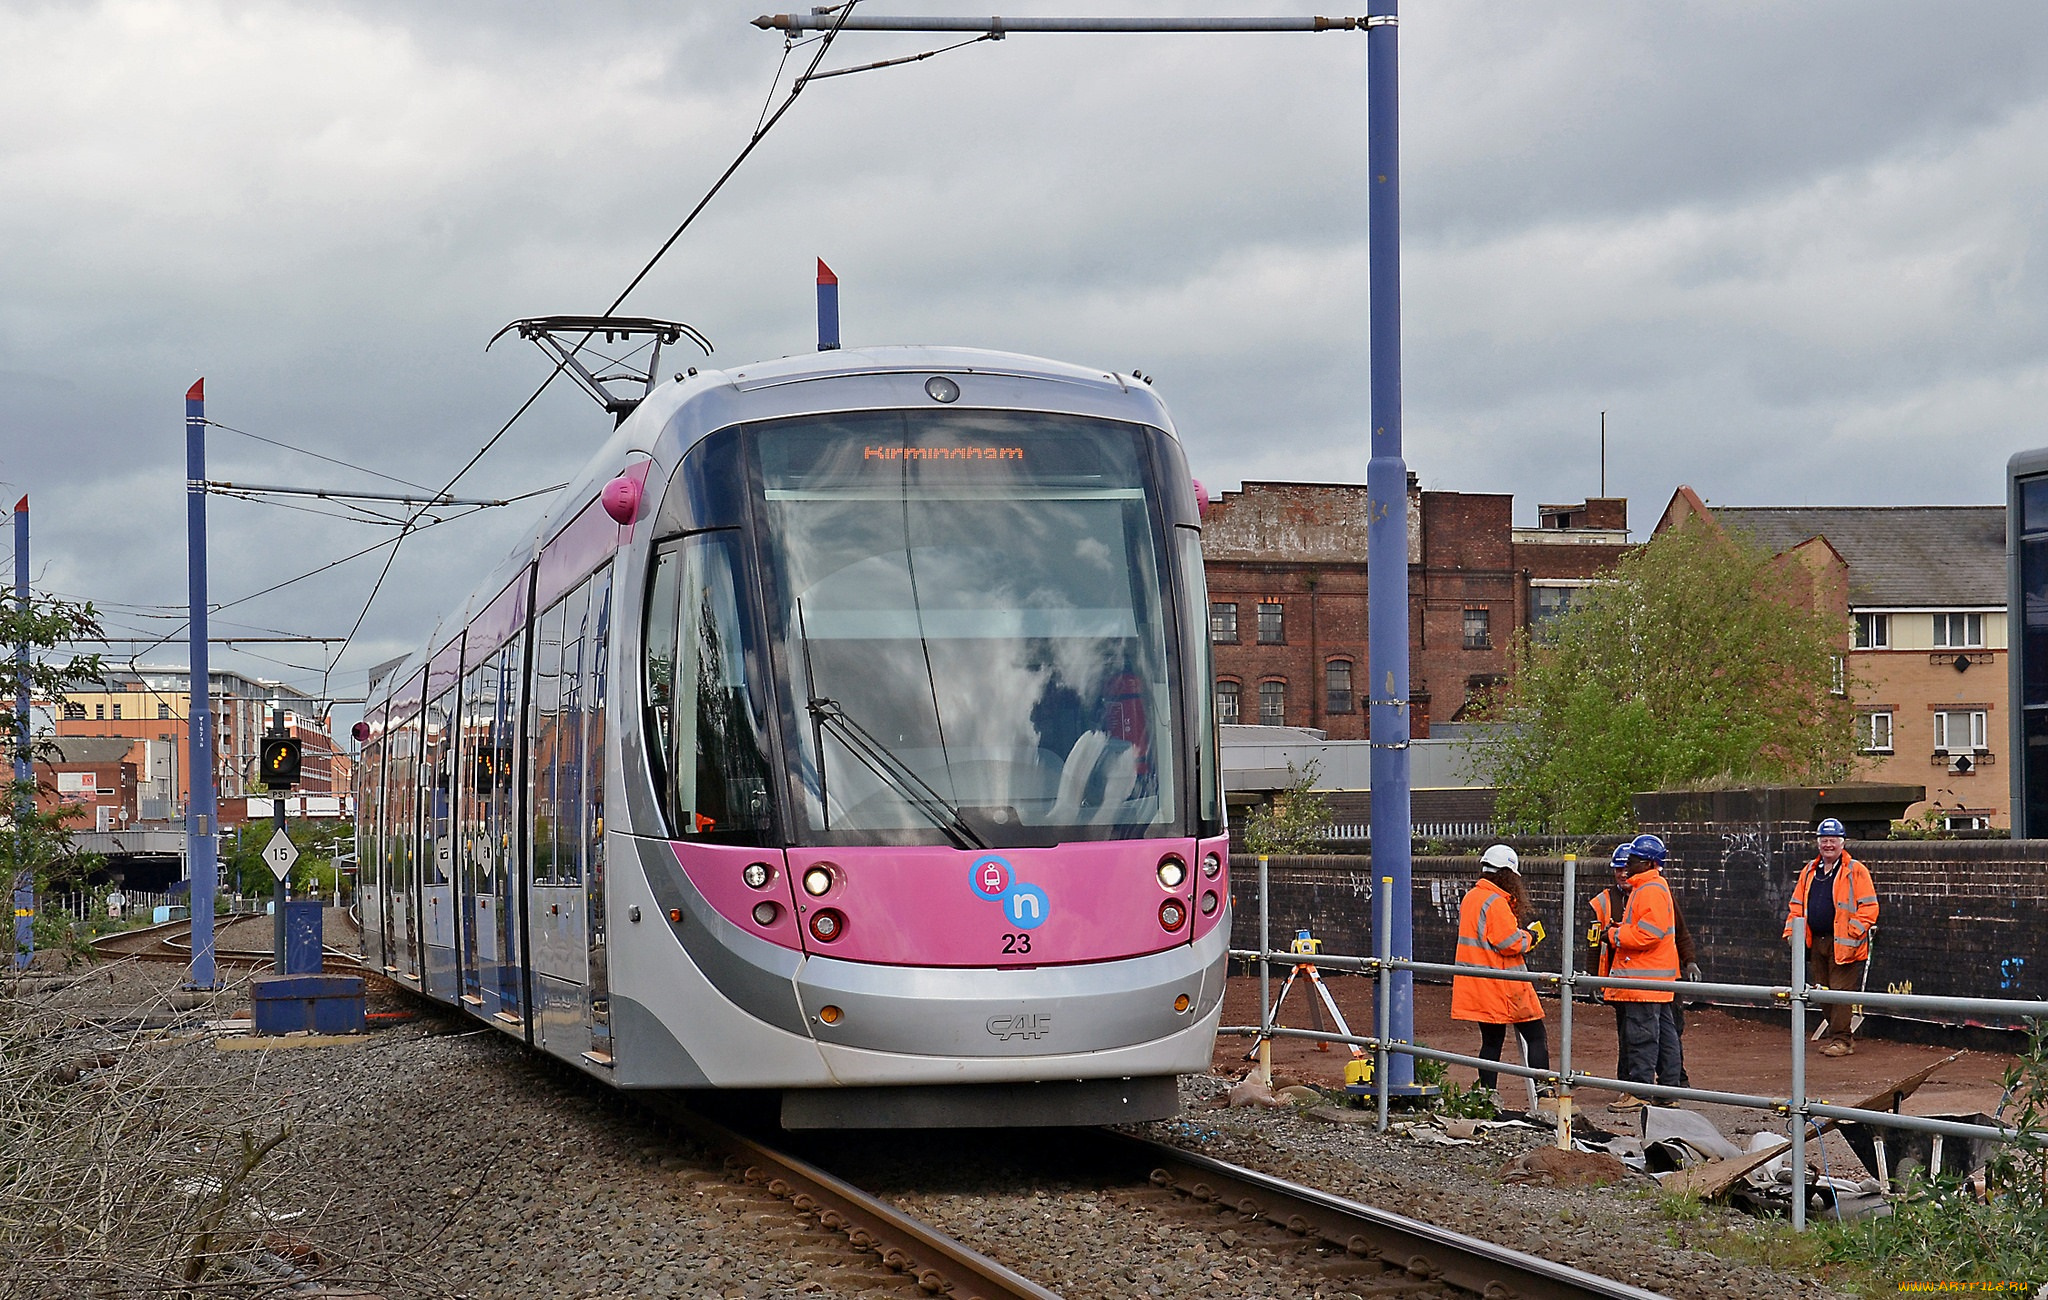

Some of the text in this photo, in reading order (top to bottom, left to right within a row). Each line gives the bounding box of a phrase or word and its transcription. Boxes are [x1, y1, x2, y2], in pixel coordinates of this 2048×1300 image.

[273, 848, 288, 860] 15
[1001, 933, 1031, 954] 23
[986, 1014, 1051, 1041] CAF
